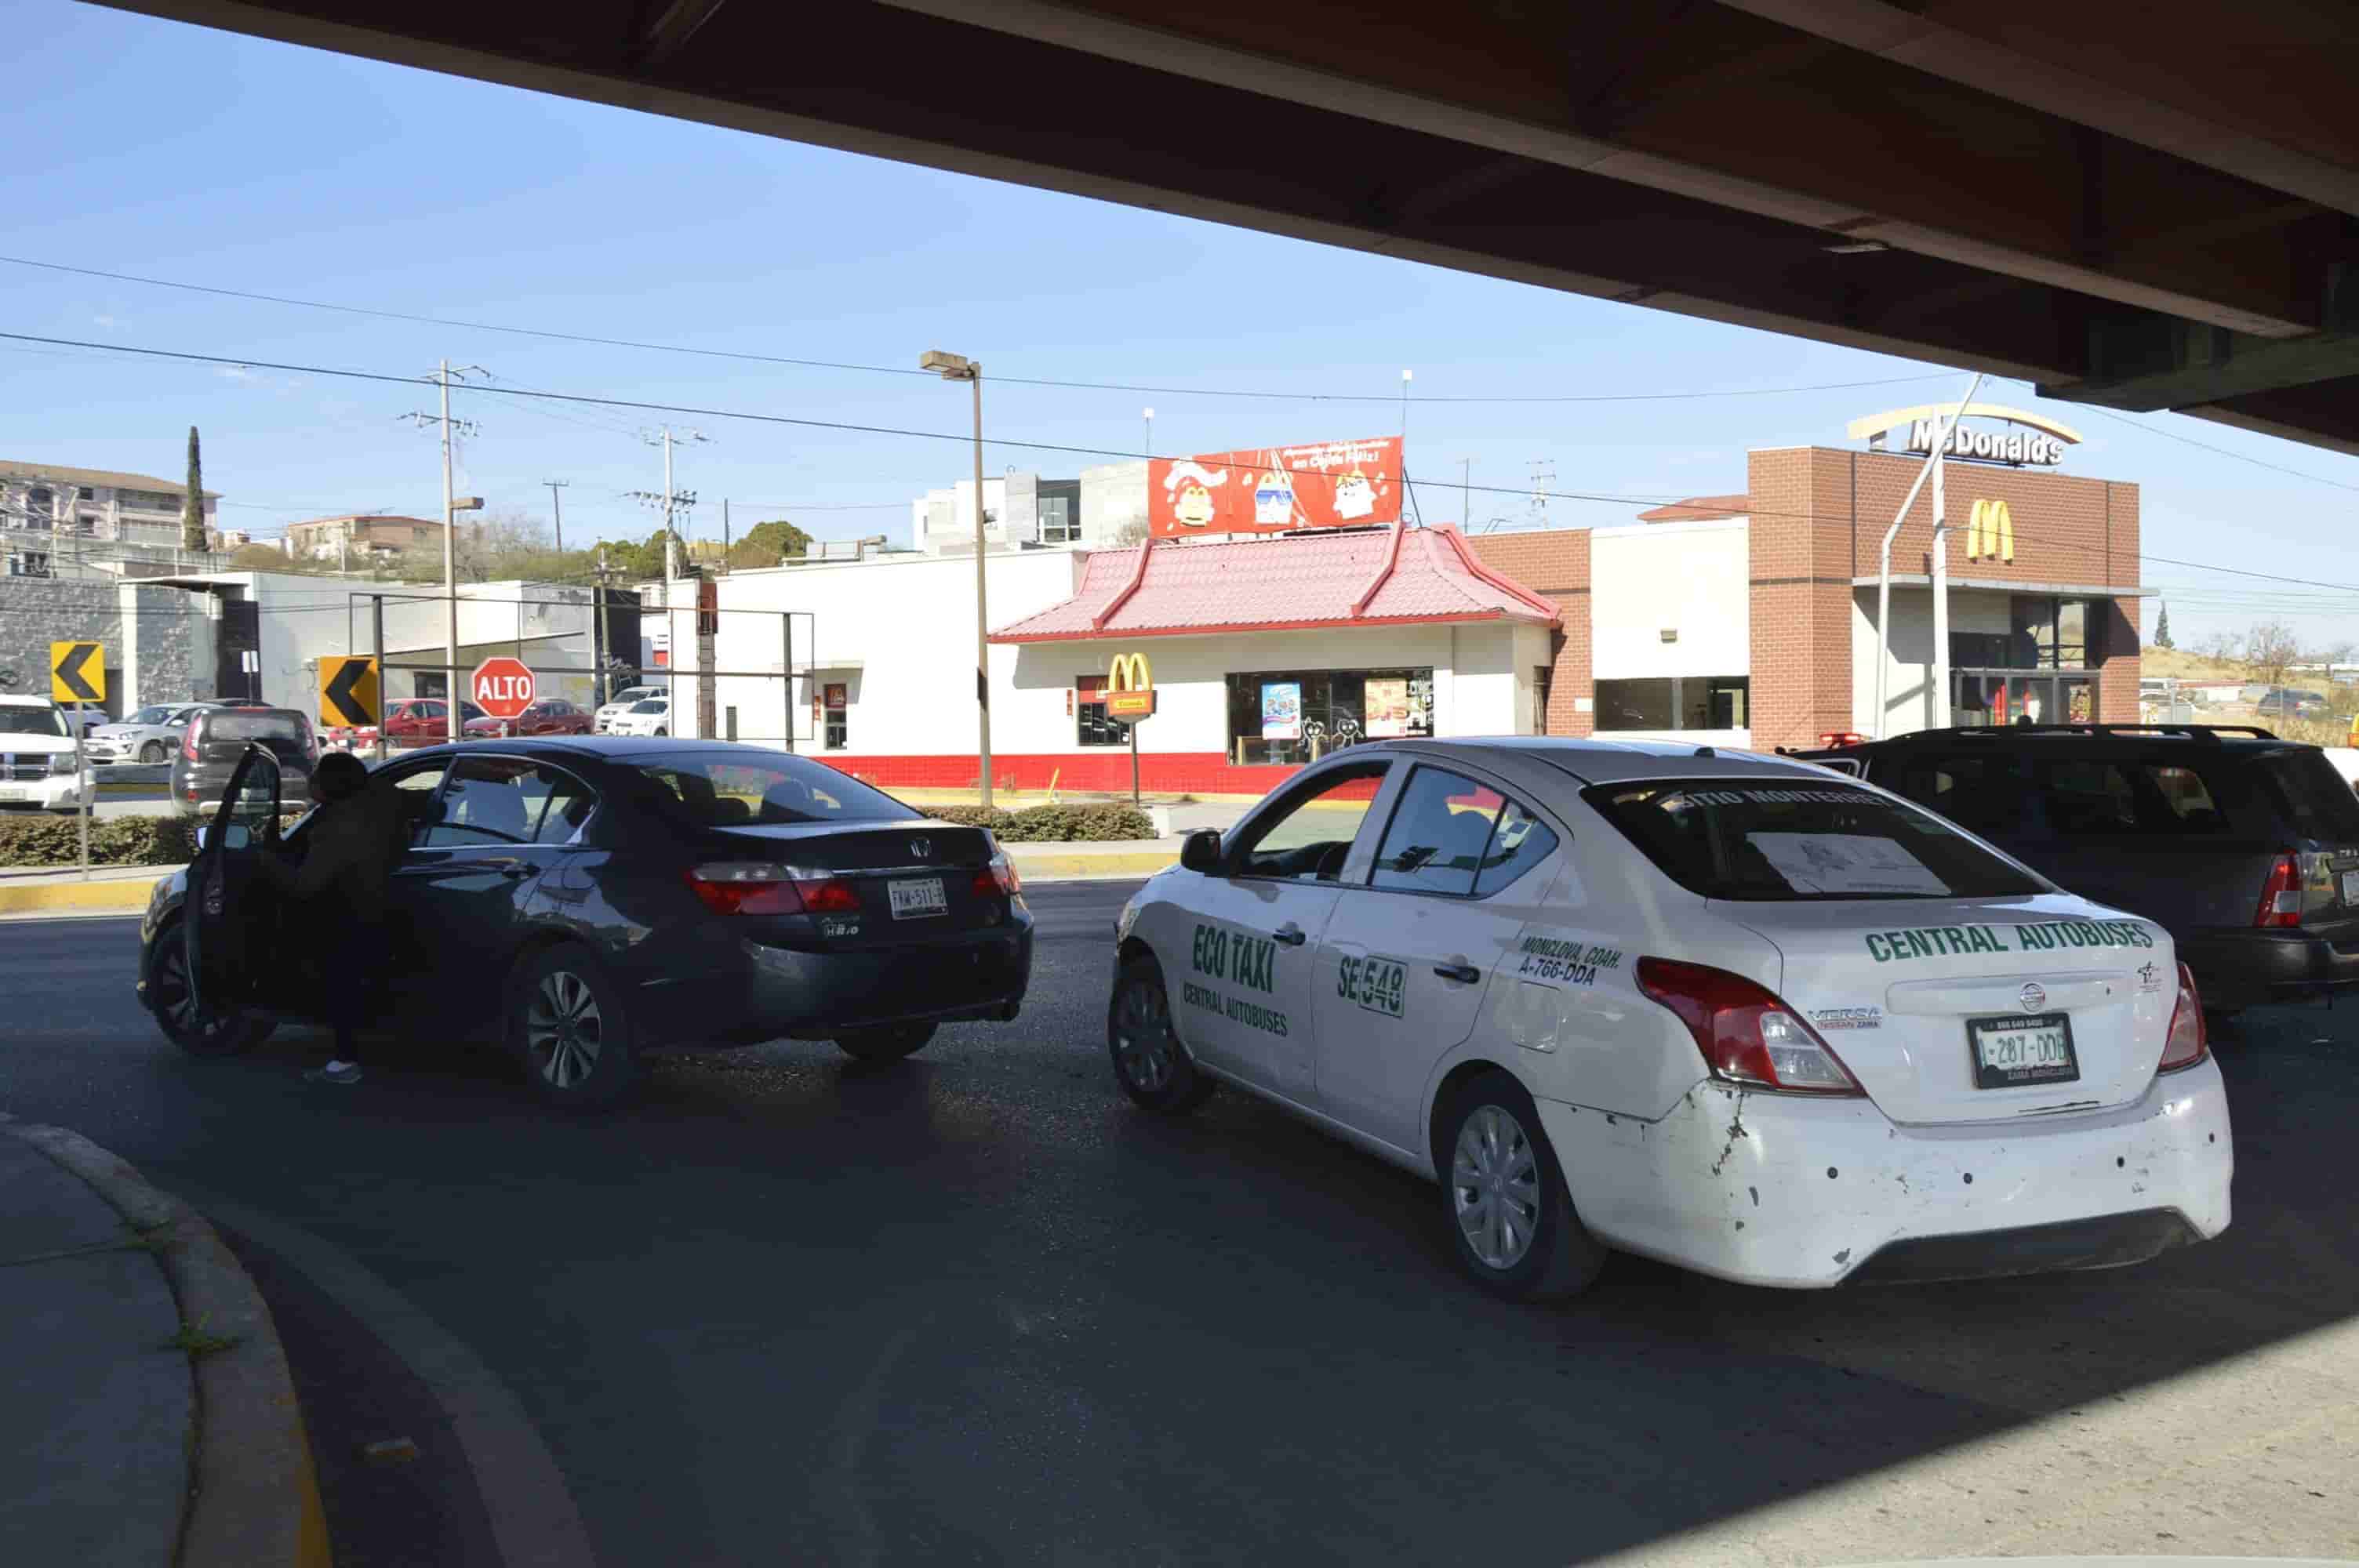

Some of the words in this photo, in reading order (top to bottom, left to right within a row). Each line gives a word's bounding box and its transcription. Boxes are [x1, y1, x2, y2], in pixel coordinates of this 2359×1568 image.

[477, 676, 531, 700] ALTO
[1745, 790, 1891, 808] MONTERREY
[1866, 926, 2009, 962] CENTRAL
[2015, 921, 2153, 950] AUTOBUSES
[1192, 924, 1227, 979] ECO
[1231, 931, 1278, 994] TAXI
[1518, 955, 1597, 986] A-766-DDA
[1183, 982, 1224, 1016] CENTRAL
[1226, 996, 1288, 1037] AUTOBUSES
[1807, 1007, 1882, 1022] VERSA
